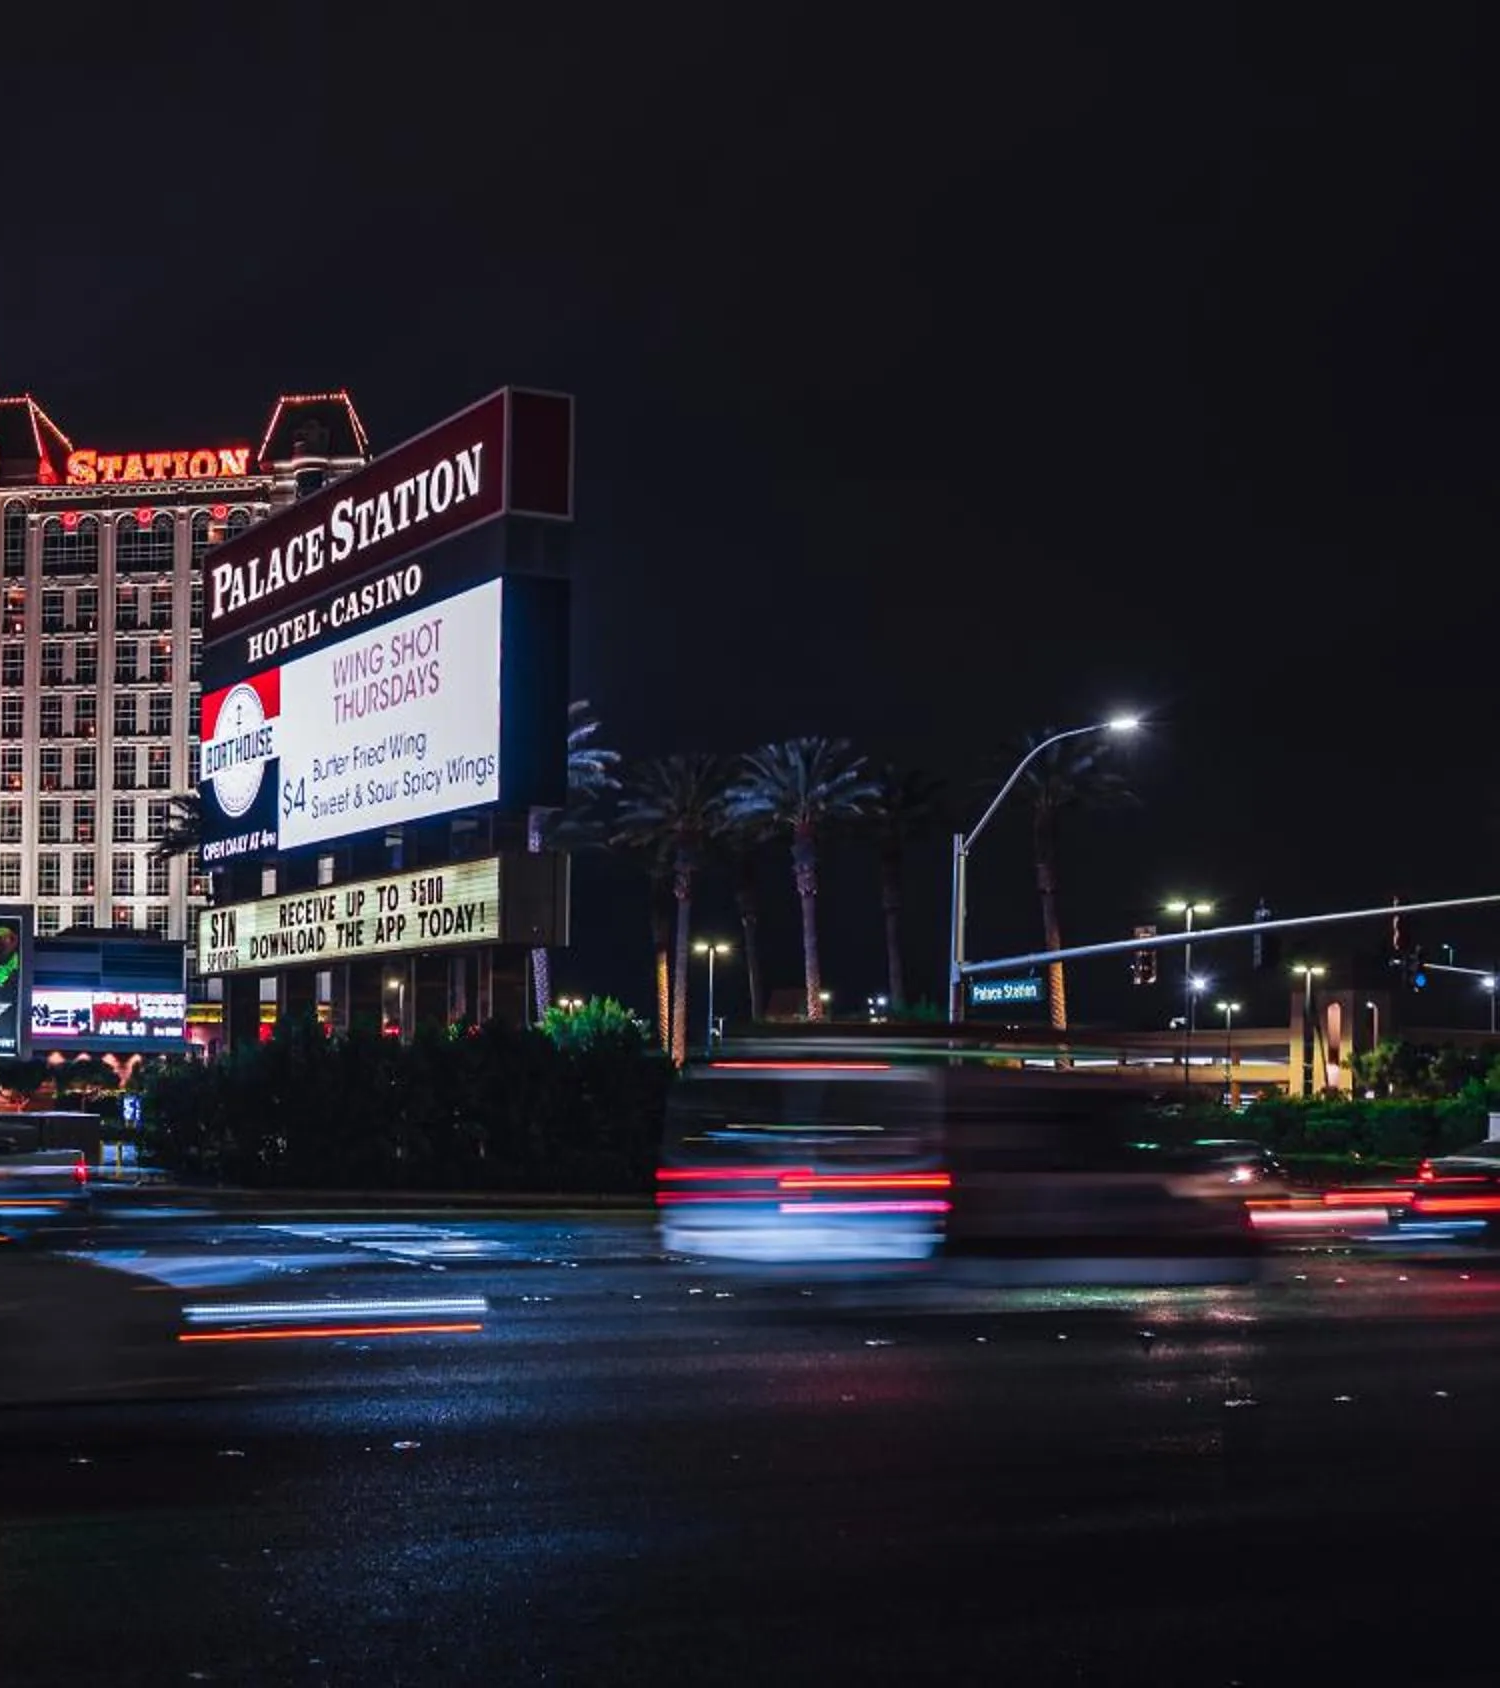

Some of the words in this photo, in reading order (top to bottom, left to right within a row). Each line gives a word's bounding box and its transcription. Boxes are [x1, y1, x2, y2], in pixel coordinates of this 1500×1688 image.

[66, 448, 250, 485] STATION
[212, 523, 325, 620] PALACE
[330, 441, 483, 565] STATION
[333, 643, 384, 688] WING
[389, 618, 442, 668] SHOT
[333, 660, 440, 725] THURSDAYS
[206, 725, 273, 774] BOATHOUSE
[352, 738, 386, 770] Fried
[389, 732, 427, 761] Wing
[282, 776, 306, 819] $4
[311, 786, 350, 819] Sweet
[354, 783, 364, 809] &
[367, 779, 399, 805] Sour
[403, 767, 443, 799] Spicy
[447, 753, 496, 786] Wings
[203, 840, 225, 861] OPEN
[226, 833, 249, 857] DAILY
[249, 831, 260, 851] AT
[279, 894, 337, 928] RECEIVE
[346, 889, 365, 918] UP
[376, 884, 399, 913] TO
[411, 876, 443, 906] $500
[211, 910, 237, 949] STN
[250, 925, 326, 961] DOWNLOAD
[336, 920, 363, 948] THE
[375, 914, 406, 945] APP
[973, 985, 1002, 1001] Palace
[99, 1021, 130, 1036] APRIL
